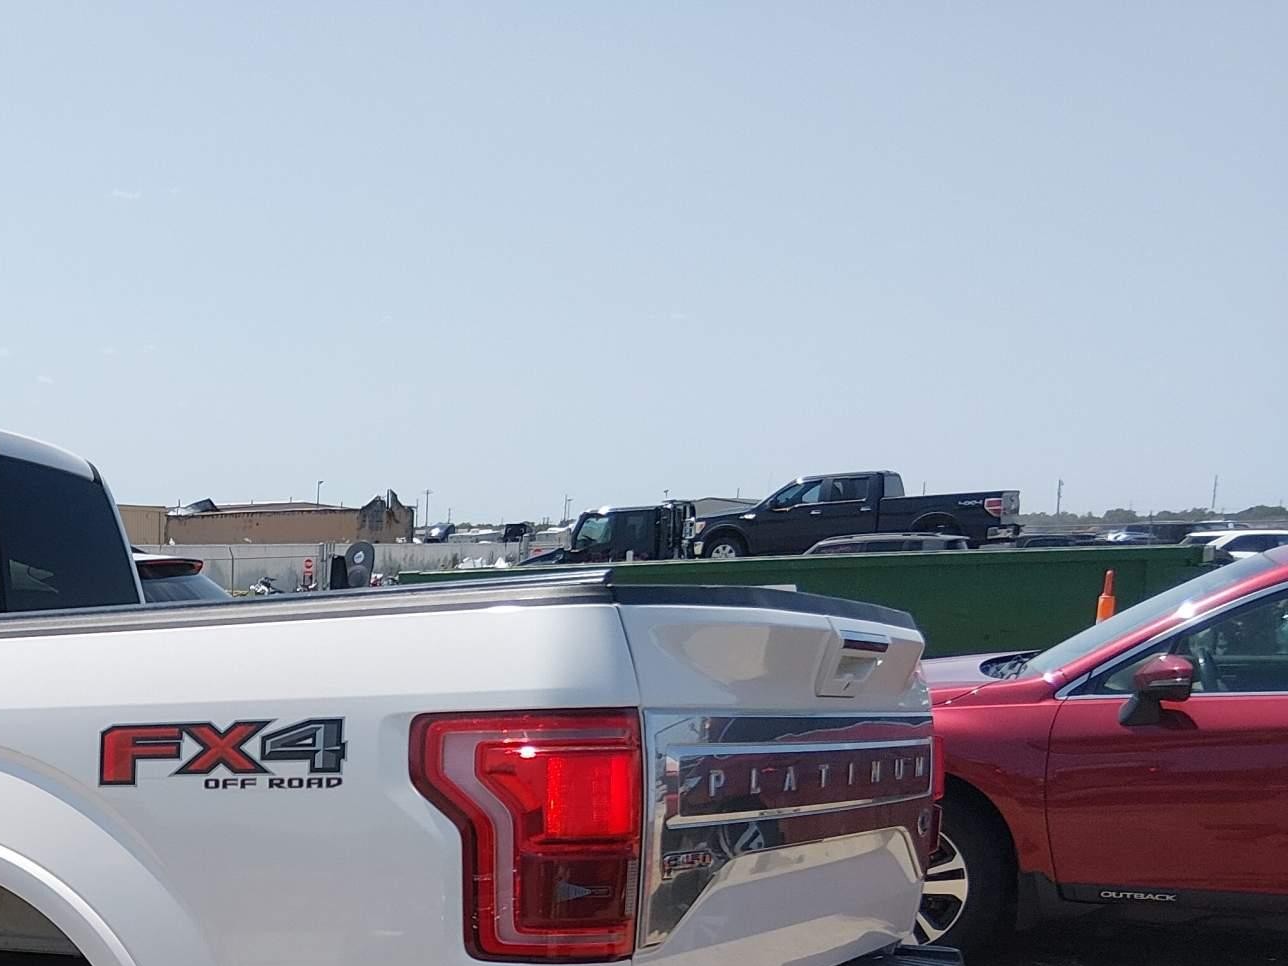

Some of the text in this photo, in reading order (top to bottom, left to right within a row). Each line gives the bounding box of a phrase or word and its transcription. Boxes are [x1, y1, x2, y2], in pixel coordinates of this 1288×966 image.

[97, 717, 347, 788] FX4
[204, 777, 344, 790] OFF ROAD
[708, 756, 926, 797] PLATINUM
[1100, 891, 1177, 902] OUTBACK
